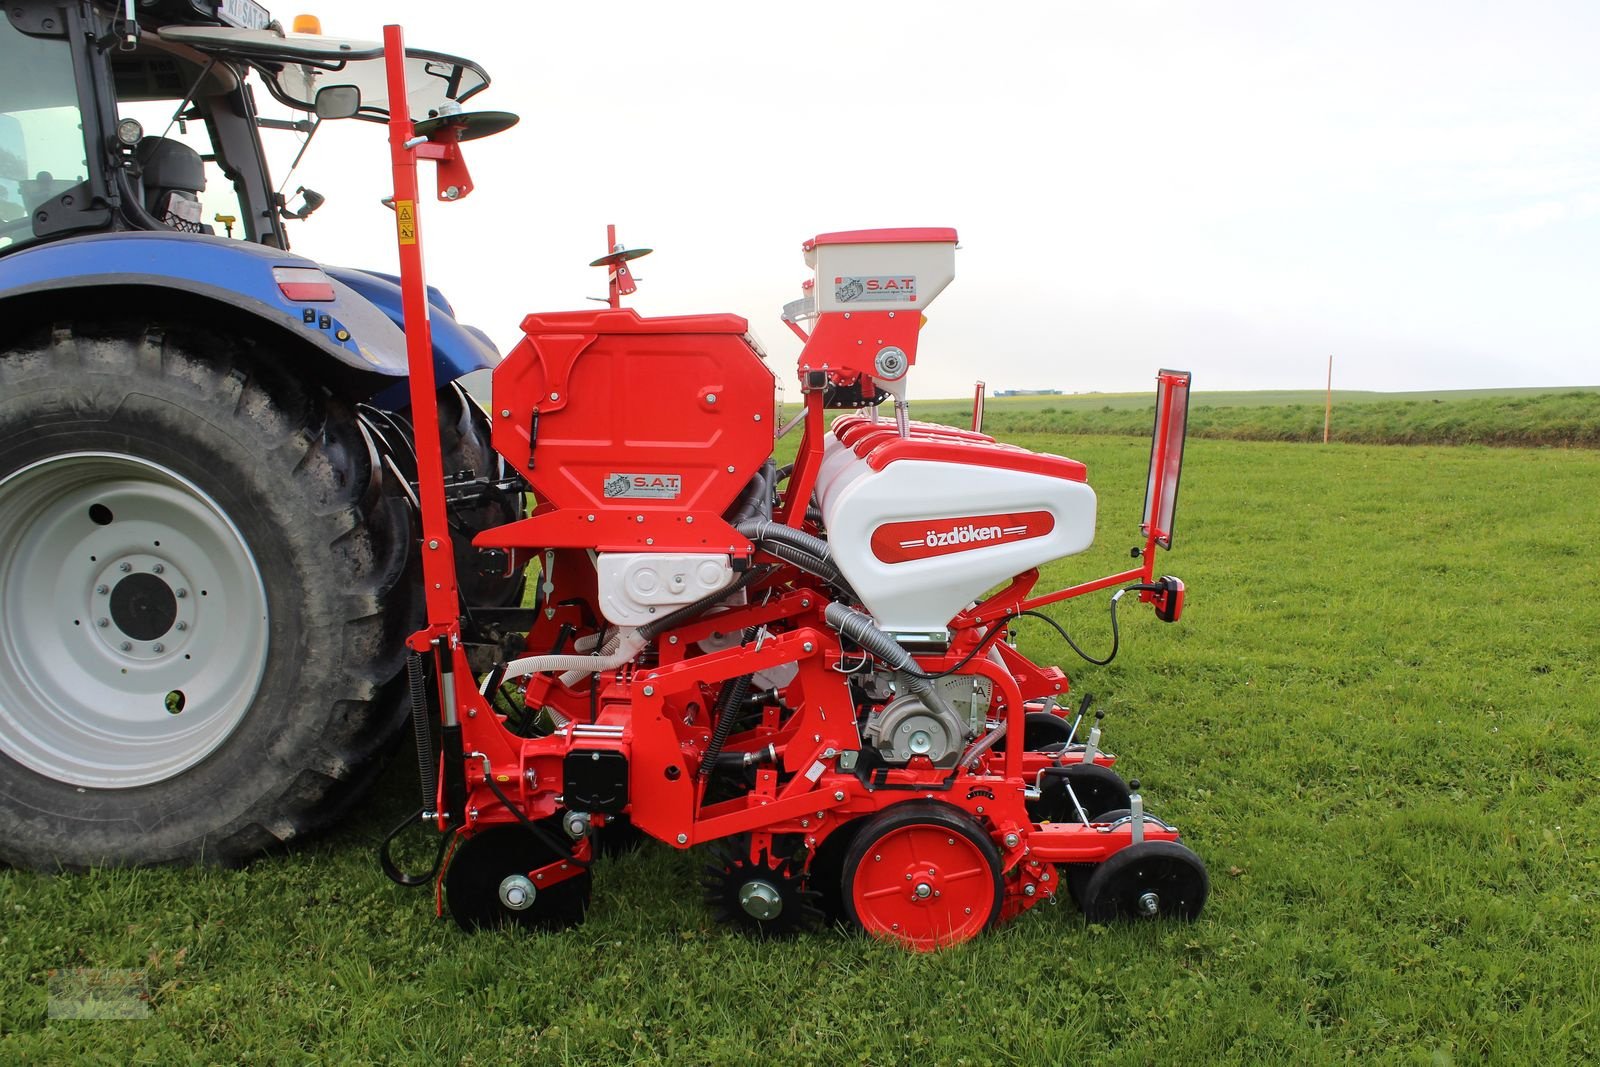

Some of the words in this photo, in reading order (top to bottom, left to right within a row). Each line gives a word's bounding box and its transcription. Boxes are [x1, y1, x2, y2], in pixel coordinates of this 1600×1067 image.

[866, 277, 914, 291] S.A.T.
[633, 477, 679, 488] S.A.T.
[925, 524, 1002, 548] özdöken
[976, 686, 986, 698] A
